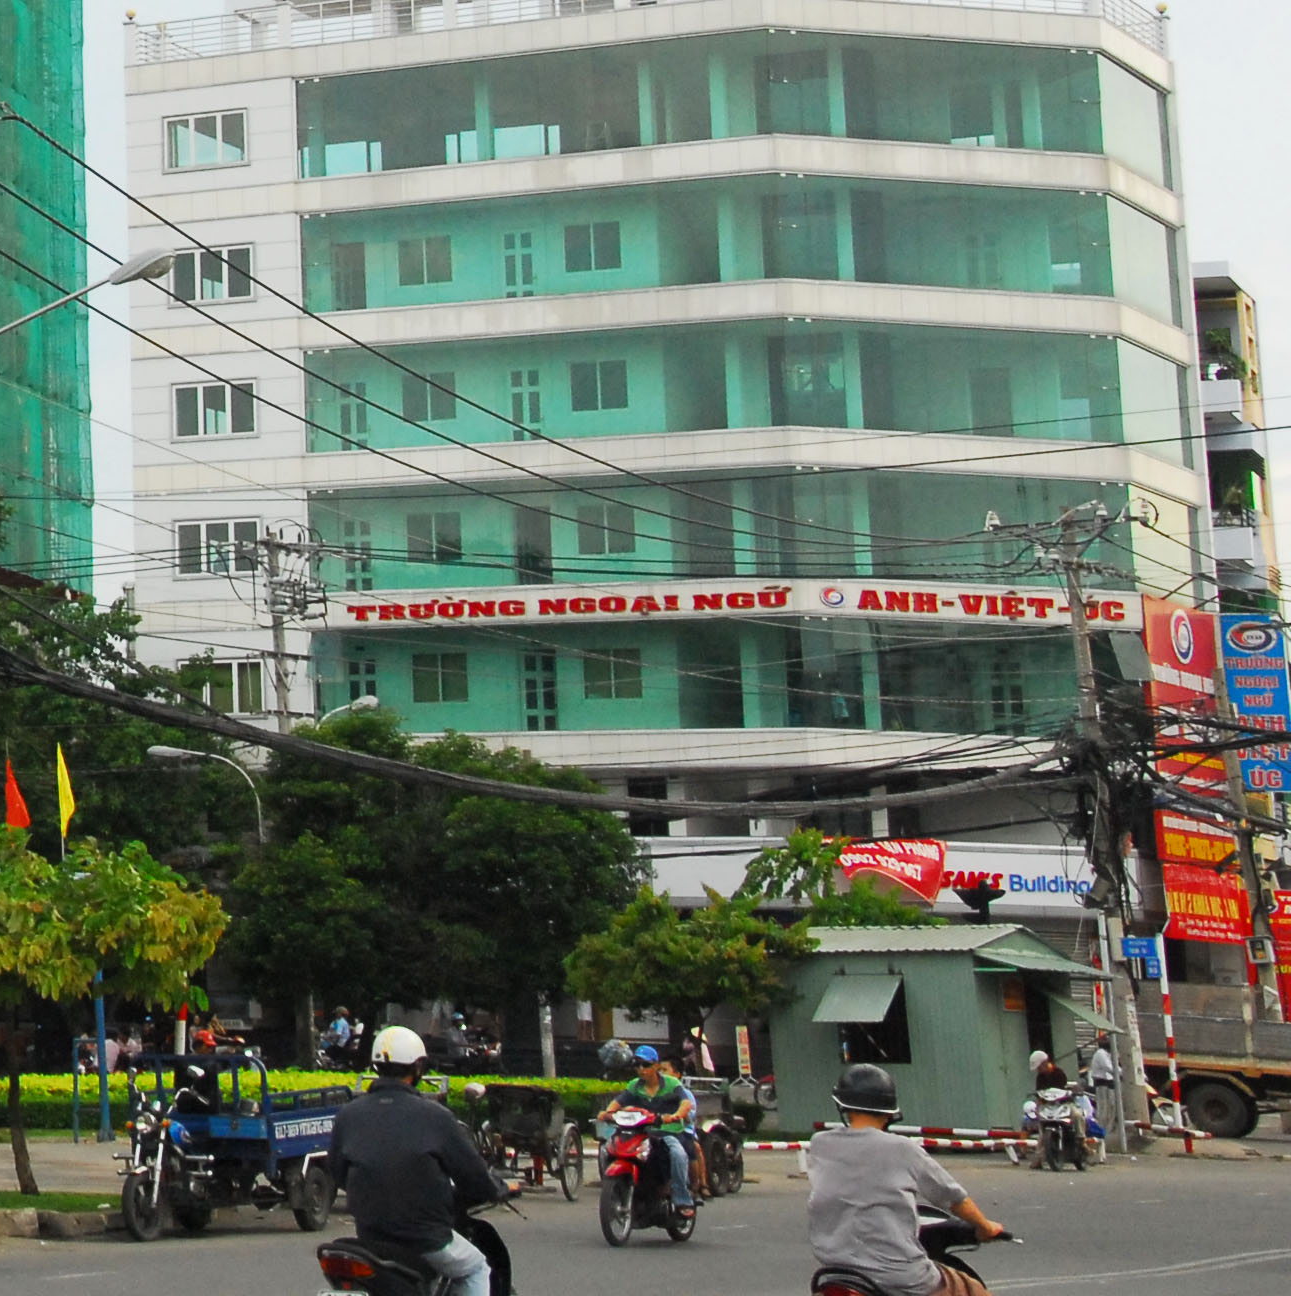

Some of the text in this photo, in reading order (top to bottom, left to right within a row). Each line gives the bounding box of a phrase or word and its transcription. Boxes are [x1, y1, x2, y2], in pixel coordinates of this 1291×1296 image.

[347, 595, 526, 622] TRƯỜNG
[538, 594, 680, 616] NGOẠI
[693, 585, 793, 611] NGỮ
[1248, 764, 1283, 789] ÚC
[1008, 873, 1092, 895] Building
